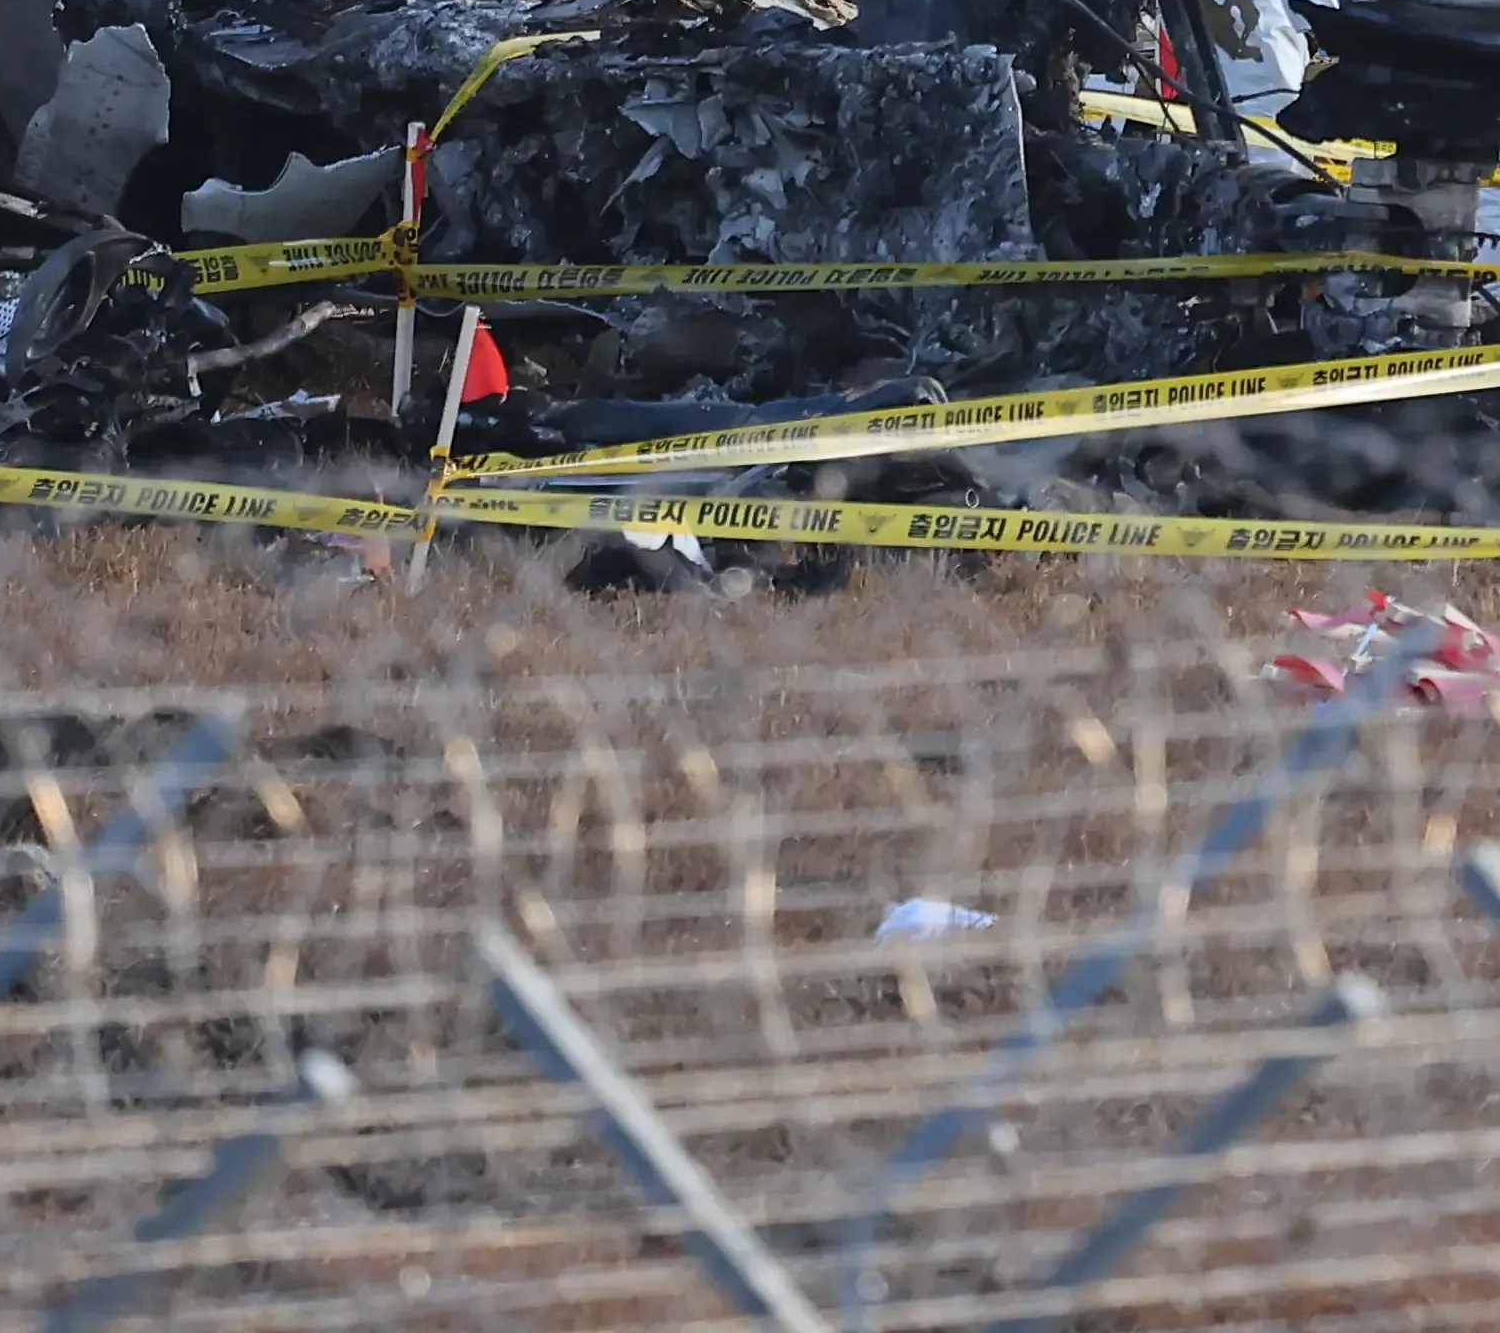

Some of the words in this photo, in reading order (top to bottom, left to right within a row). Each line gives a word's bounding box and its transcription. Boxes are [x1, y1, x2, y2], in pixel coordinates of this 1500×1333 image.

[681, 268, 734, 285] LINE
[132, 485, 222, 516] POLICE
[225, 494, 279, 521] LINE
[696, 502, 781, 530] POLICE
[787, 507, 844, 533] LINE
[907, 513, 1008, 542] 출입금지
[1018, 519, 1102, 546] POLICE
[1108, 523, 1163, 548] LINE
[1226, 527, 1326, 552] 출입금지
